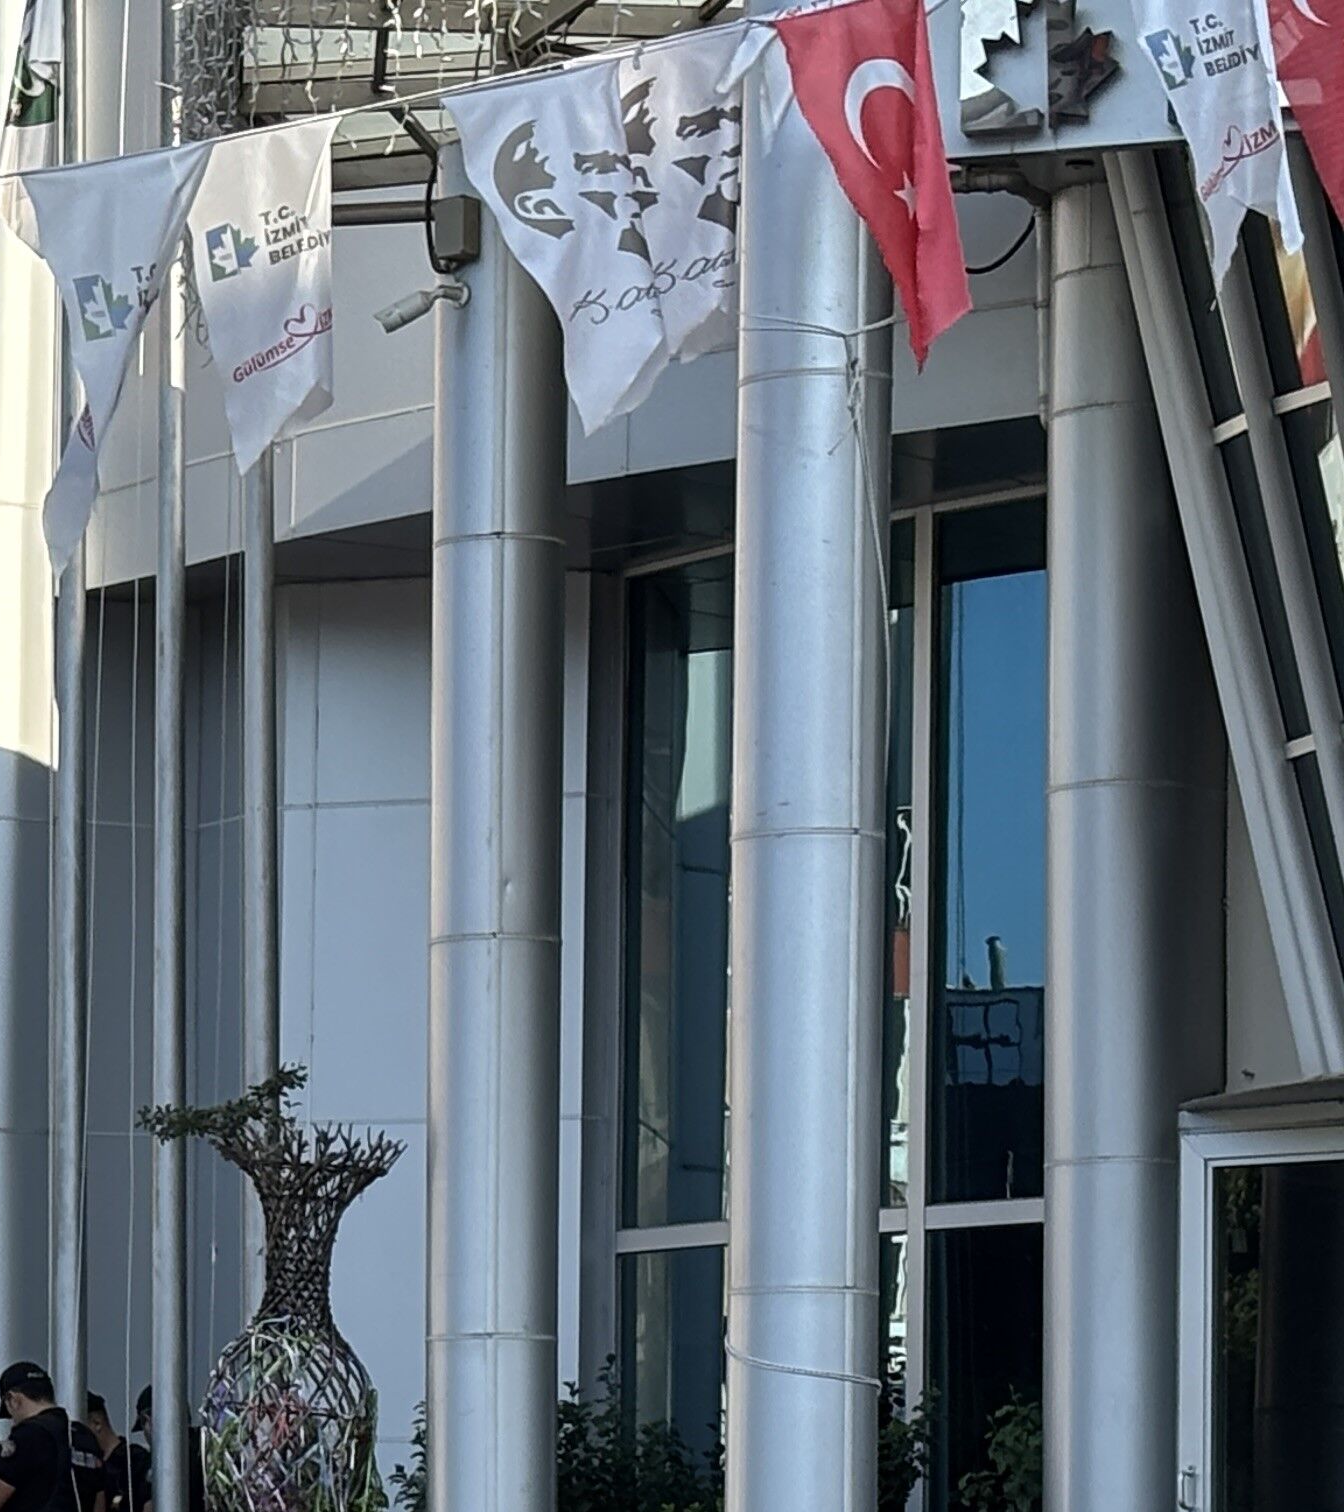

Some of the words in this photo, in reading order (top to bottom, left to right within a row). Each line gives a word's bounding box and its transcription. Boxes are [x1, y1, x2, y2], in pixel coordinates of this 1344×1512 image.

[1189, 14, 1223, 35] T.C.
[1196, 29, 1235, 56] İZMİT
[259, 205, 296, 226] T.C.
